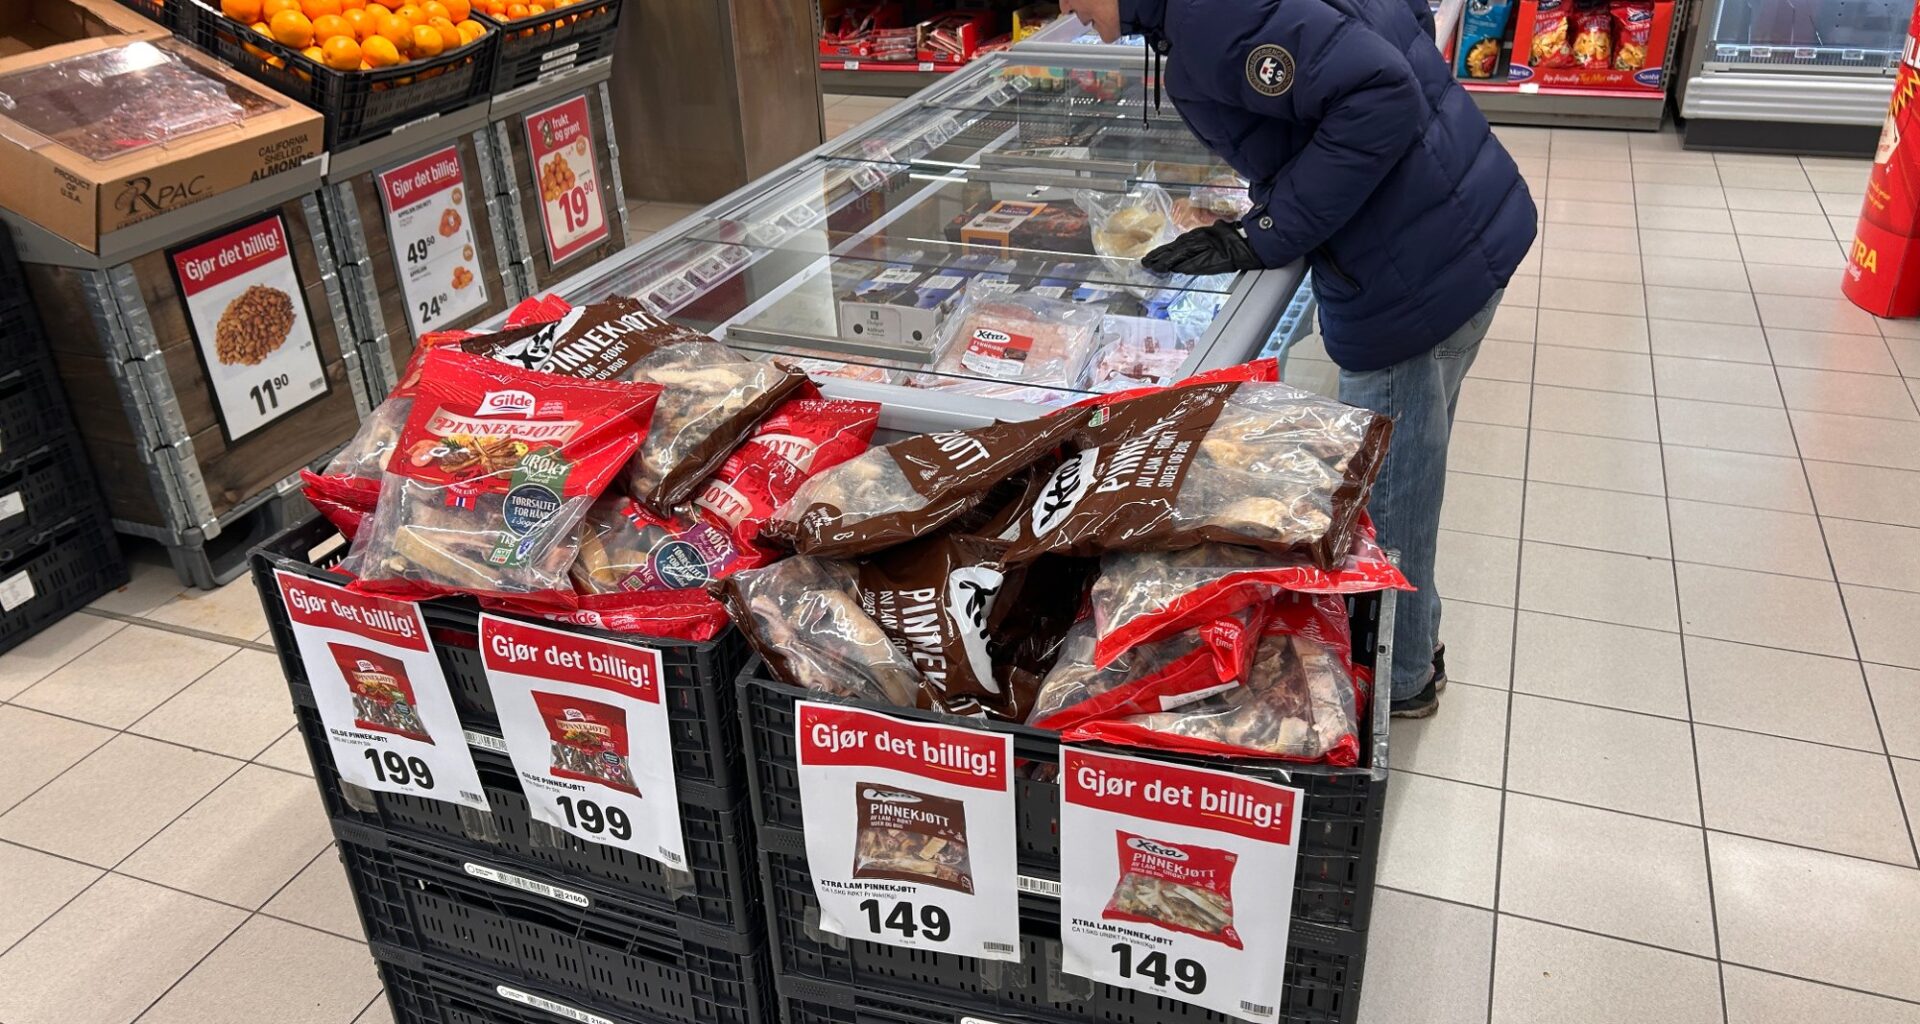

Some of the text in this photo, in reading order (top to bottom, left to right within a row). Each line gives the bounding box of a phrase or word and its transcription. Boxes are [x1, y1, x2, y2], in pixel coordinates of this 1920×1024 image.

[552, 113, 570, 129] frukt
[258, 135, 309, 157] CALIFORNIA
[265, 145, 303, 166] SHELLED
[392, 157, 460, 199] Gjør det billig!
[184, 228, 281, 282] Gjør det billig!
[489, 394, 533, 407] Gilde
[511, 495, 558, 511] TØRRSALTET
[513, 506, 529, 518] FOR
[289, 587, 417, 638] Gjør det billig!
[491, 634, 651, 688] Gjør det billig!
[330, 727, 349, 737] GILDE
[348, 731, 388, 743] PINNEKJØTT
[811, 722, 998, 777] Gjør det billig!
[364, 747, 435, 790] 199
[521, 770, 586, 792] GILDE PINNEKJØTT
[1077, 766, 1284, 829] Gjør det billig!
[556, 795, 633, 841] 199
[870, 803, 950, 827] PINNEKJØTT
[1133, 851, 1216, 878] PINNEKJØTT
[821, 878, 918, 894] XTRA LAM PINNEKJØTT
[859, 898, 952, 943] 149
[1072, 917, 1174, 947] XTRA LAM PINNEKJØTT
[1111, 941, 1208, 995] 149
